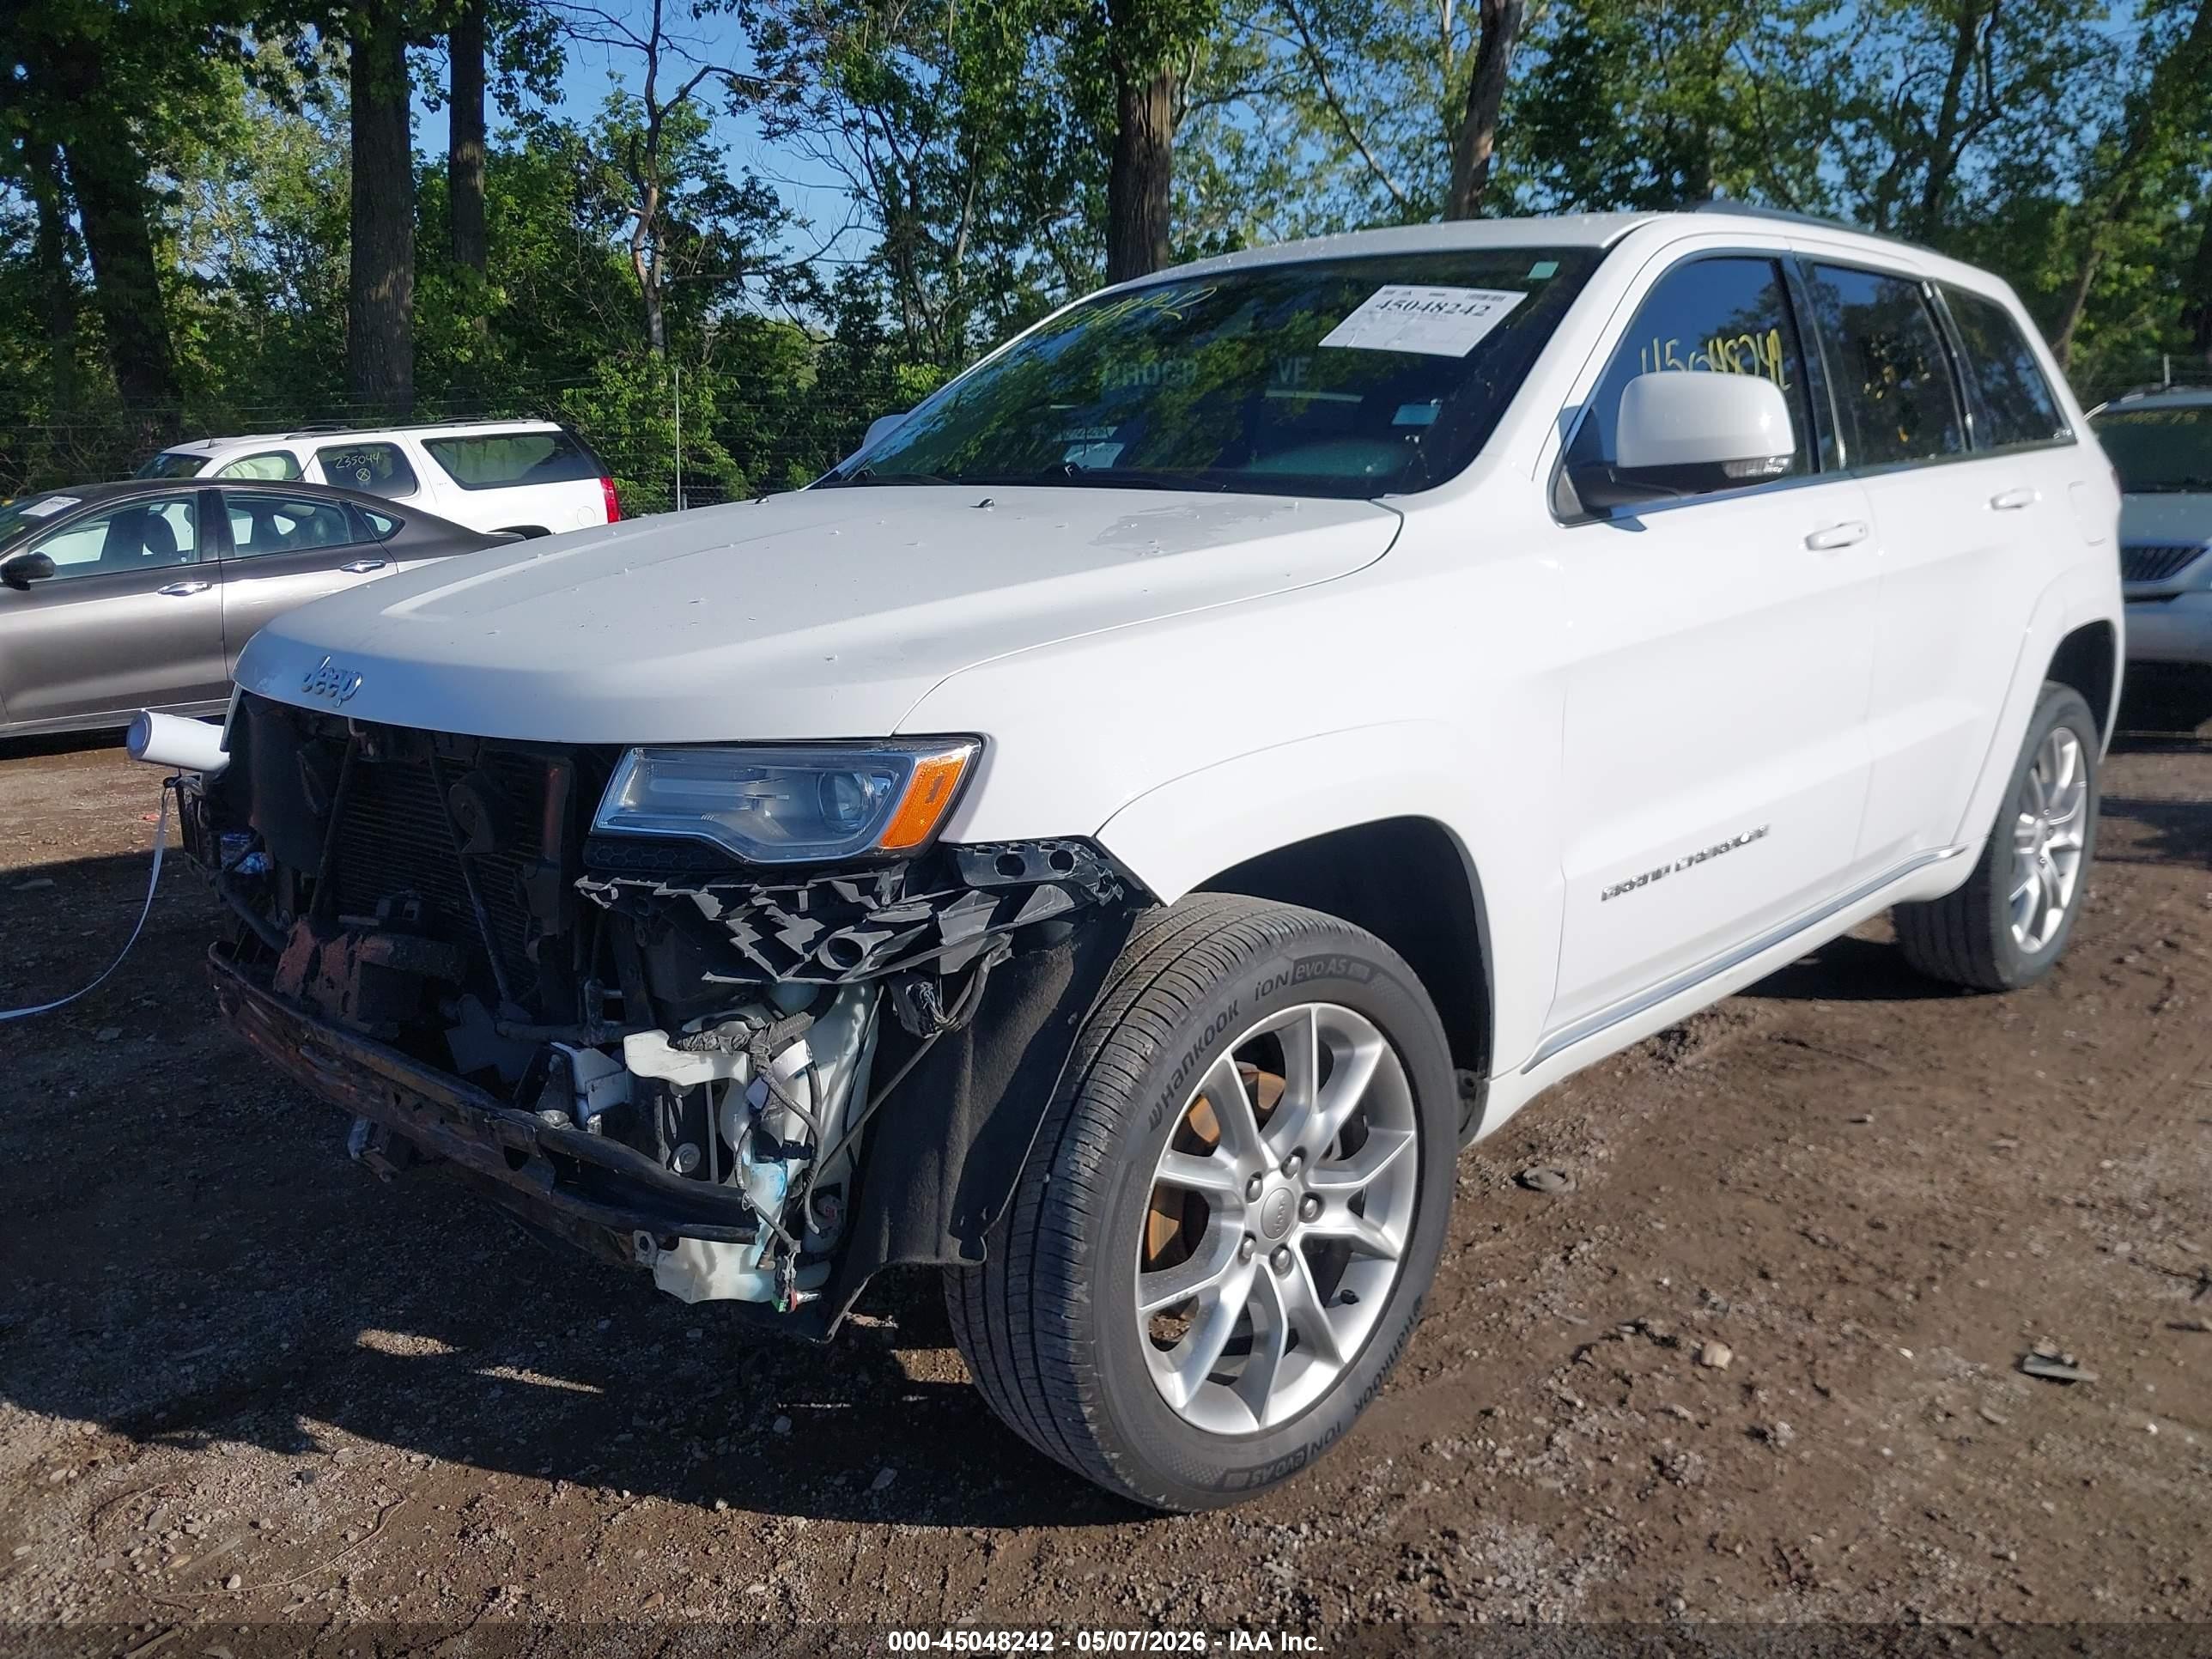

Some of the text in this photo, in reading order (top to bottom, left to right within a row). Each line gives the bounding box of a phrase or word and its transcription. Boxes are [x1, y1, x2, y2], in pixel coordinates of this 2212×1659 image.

[1375, 298, 1492, 318] 45048242
[333, 452, 381, 470] 235044
[301, 653, 365, 708] Jeep
